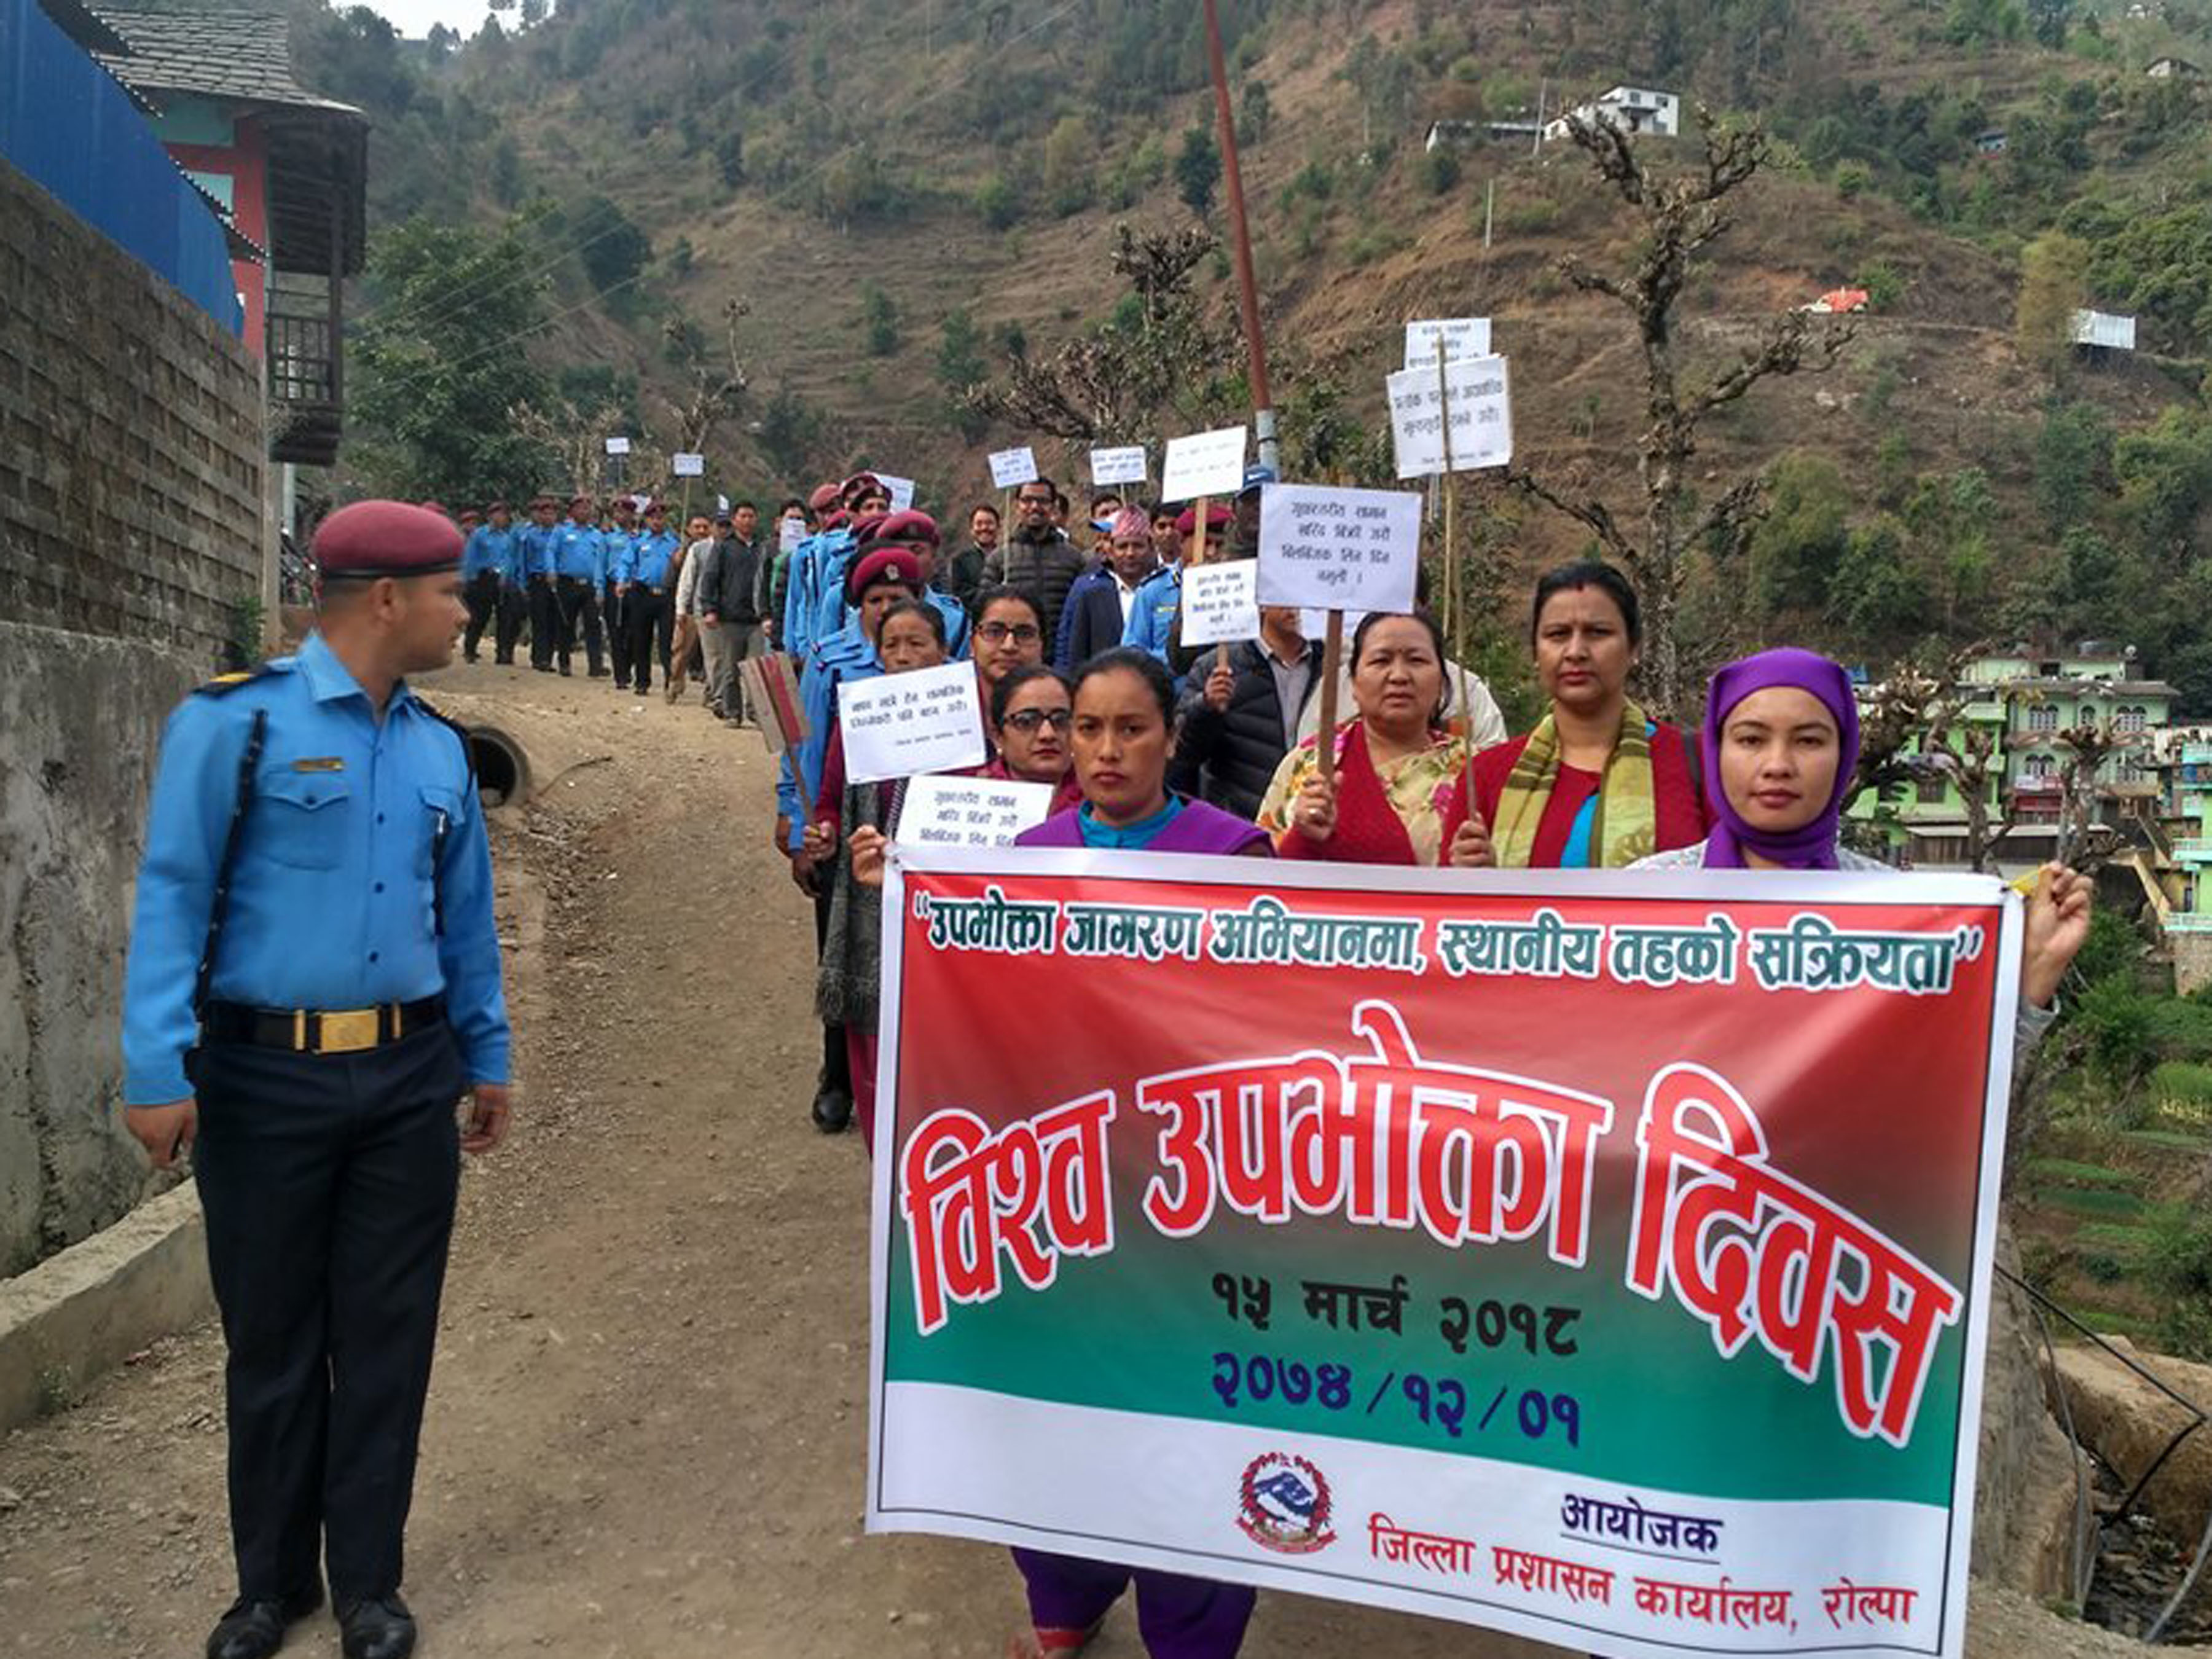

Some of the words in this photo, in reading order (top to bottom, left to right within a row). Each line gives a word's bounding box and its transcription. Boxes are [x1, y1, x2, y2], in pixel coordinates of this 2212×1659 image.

[1062, 898, 1206, 960] जागरण
[1210, 895, 1425, 973] अभियानमा,
[1437, 907, 1605, 978] स्थानीय
[1609, 911, 1741, 987] तहको
[900, 1088, 1116, 1337] विश्व
[1135, 998, 1614, 1268] उपभोक्ता
[1625, 1061, 1964, 1448] दिवस
[1212, 1272, 1271, 1331] १५
[1301, 1274, 1410, 1336] मार्च
[1440, 1296, 1582, 1355] २०१८
[1559, 1491, 1724, 1553] आयोजक
[1367, 1512, 1476, 1574] जिल्ला
[1492, 1544, 1614, 1606] प्रशासन
[1633, 1574, 1799, 1636] कार्यालय,
[1821, 1575, 1919, 1628] रोल्पा
